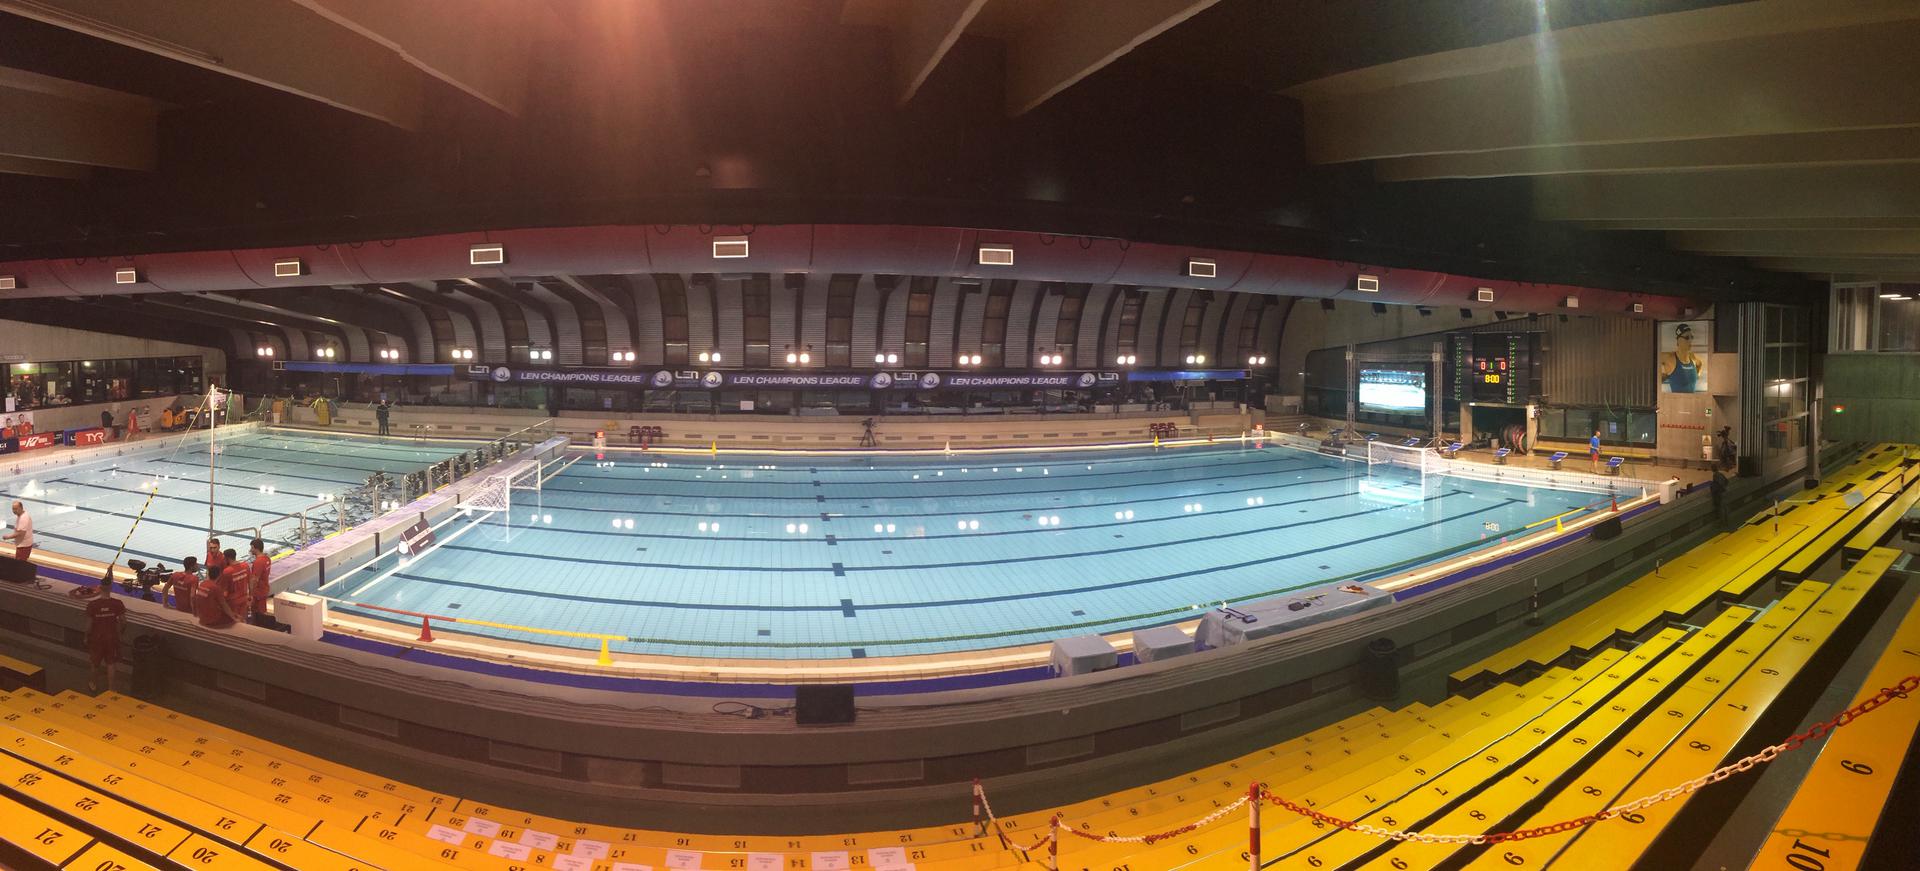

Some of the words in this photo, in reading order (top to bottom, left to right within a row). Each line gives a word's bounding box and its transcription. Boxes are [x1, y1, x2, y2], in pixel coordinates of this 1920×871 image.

[520, 372, 540, 380] LEN
[540, 372, 600, 382] CHAMPIONS
[601, 374, 641, 383] LEAGUE
[733, 376, 754, 384] LEN
[756, 376, 818, 385] CHAMPIONS
[820, 377, 861, 385] LEAGUE
[950, 378, 970, 386] LEN
[971, 377, 1030, 386] CHAMPIONS
[1031, 377, 1068, 385] LEAGUE
[86, 432, 104, 444] TYR
[1689, 741, 1711, 751] 8
[1626, 749, 1644, 757] 7
[55, 755, 73, 765] 24
[229, 763, 243, 771] 24
[1841, 760, 1873, 775] 9
[103, 774, 123, 785] 23
[271, 778, 286, 786] 23
[308, 774, 322, 783] 23
[1189, 776, 1199, 784] 6
[1524, 776, 1539, 784] 7
[354, 790, 368, 798] 22
[1435, 788, 1448, 796] 7
[1583, 786, 1602, 796] 8
[275, 794, 291, 803] 22
[317, 794, 333, 803] 22
[431, 796, 444, 805] 21
[1306, 799, 1316, 807] 7
[1365, 795, 1376, 803] 7
[75, 797, 99, 810] 22
[401, 804, 415, 812] 21
[1056, 811, 1064, 819] 9
[1470, 810, 1486, 820] 8
[1621, 813, 1645, 825] 9
[216, 817, 236, 829] 21
[449, 817, 464, 826] 20
[1312, 819, 1324, 829] 8
[1382, 817, 1396, 826] 8
[138, 823, 162, 838] 21
[379, 830, 397, 840] 20
[501, 830, 514, 838] 19
[35, 828, 63, 844] 21
[623, 833, 636, 841] 17
[270, 839, 292, 852] 20
[475, 841, 483, 849] 9
[557, 842, 570, 850] 18
[844, 838, 856, 846] 13
[971, 843, 984, 851] 11
[1187, 845, 1198, 854] 9
[193, 848, 218, 863] 20
[441, 849, 458, 859] 19
[612, 850, 625, 858] 17
[912, 850, 925, 859] 12
[1241, 851, 1251, 862] 9
[1504, 852, 1524, 865] 9
[1786, 838, 1830, 871] 10
[536, 855, 545, 863] 8
[731, 859, 743, 867] 15
[791, 859, 804, 867] 14
[851, 856, 864, 864] 13
[1308, 856, 1322, 867] 9
[1391, 858, 1408, 870] 9
